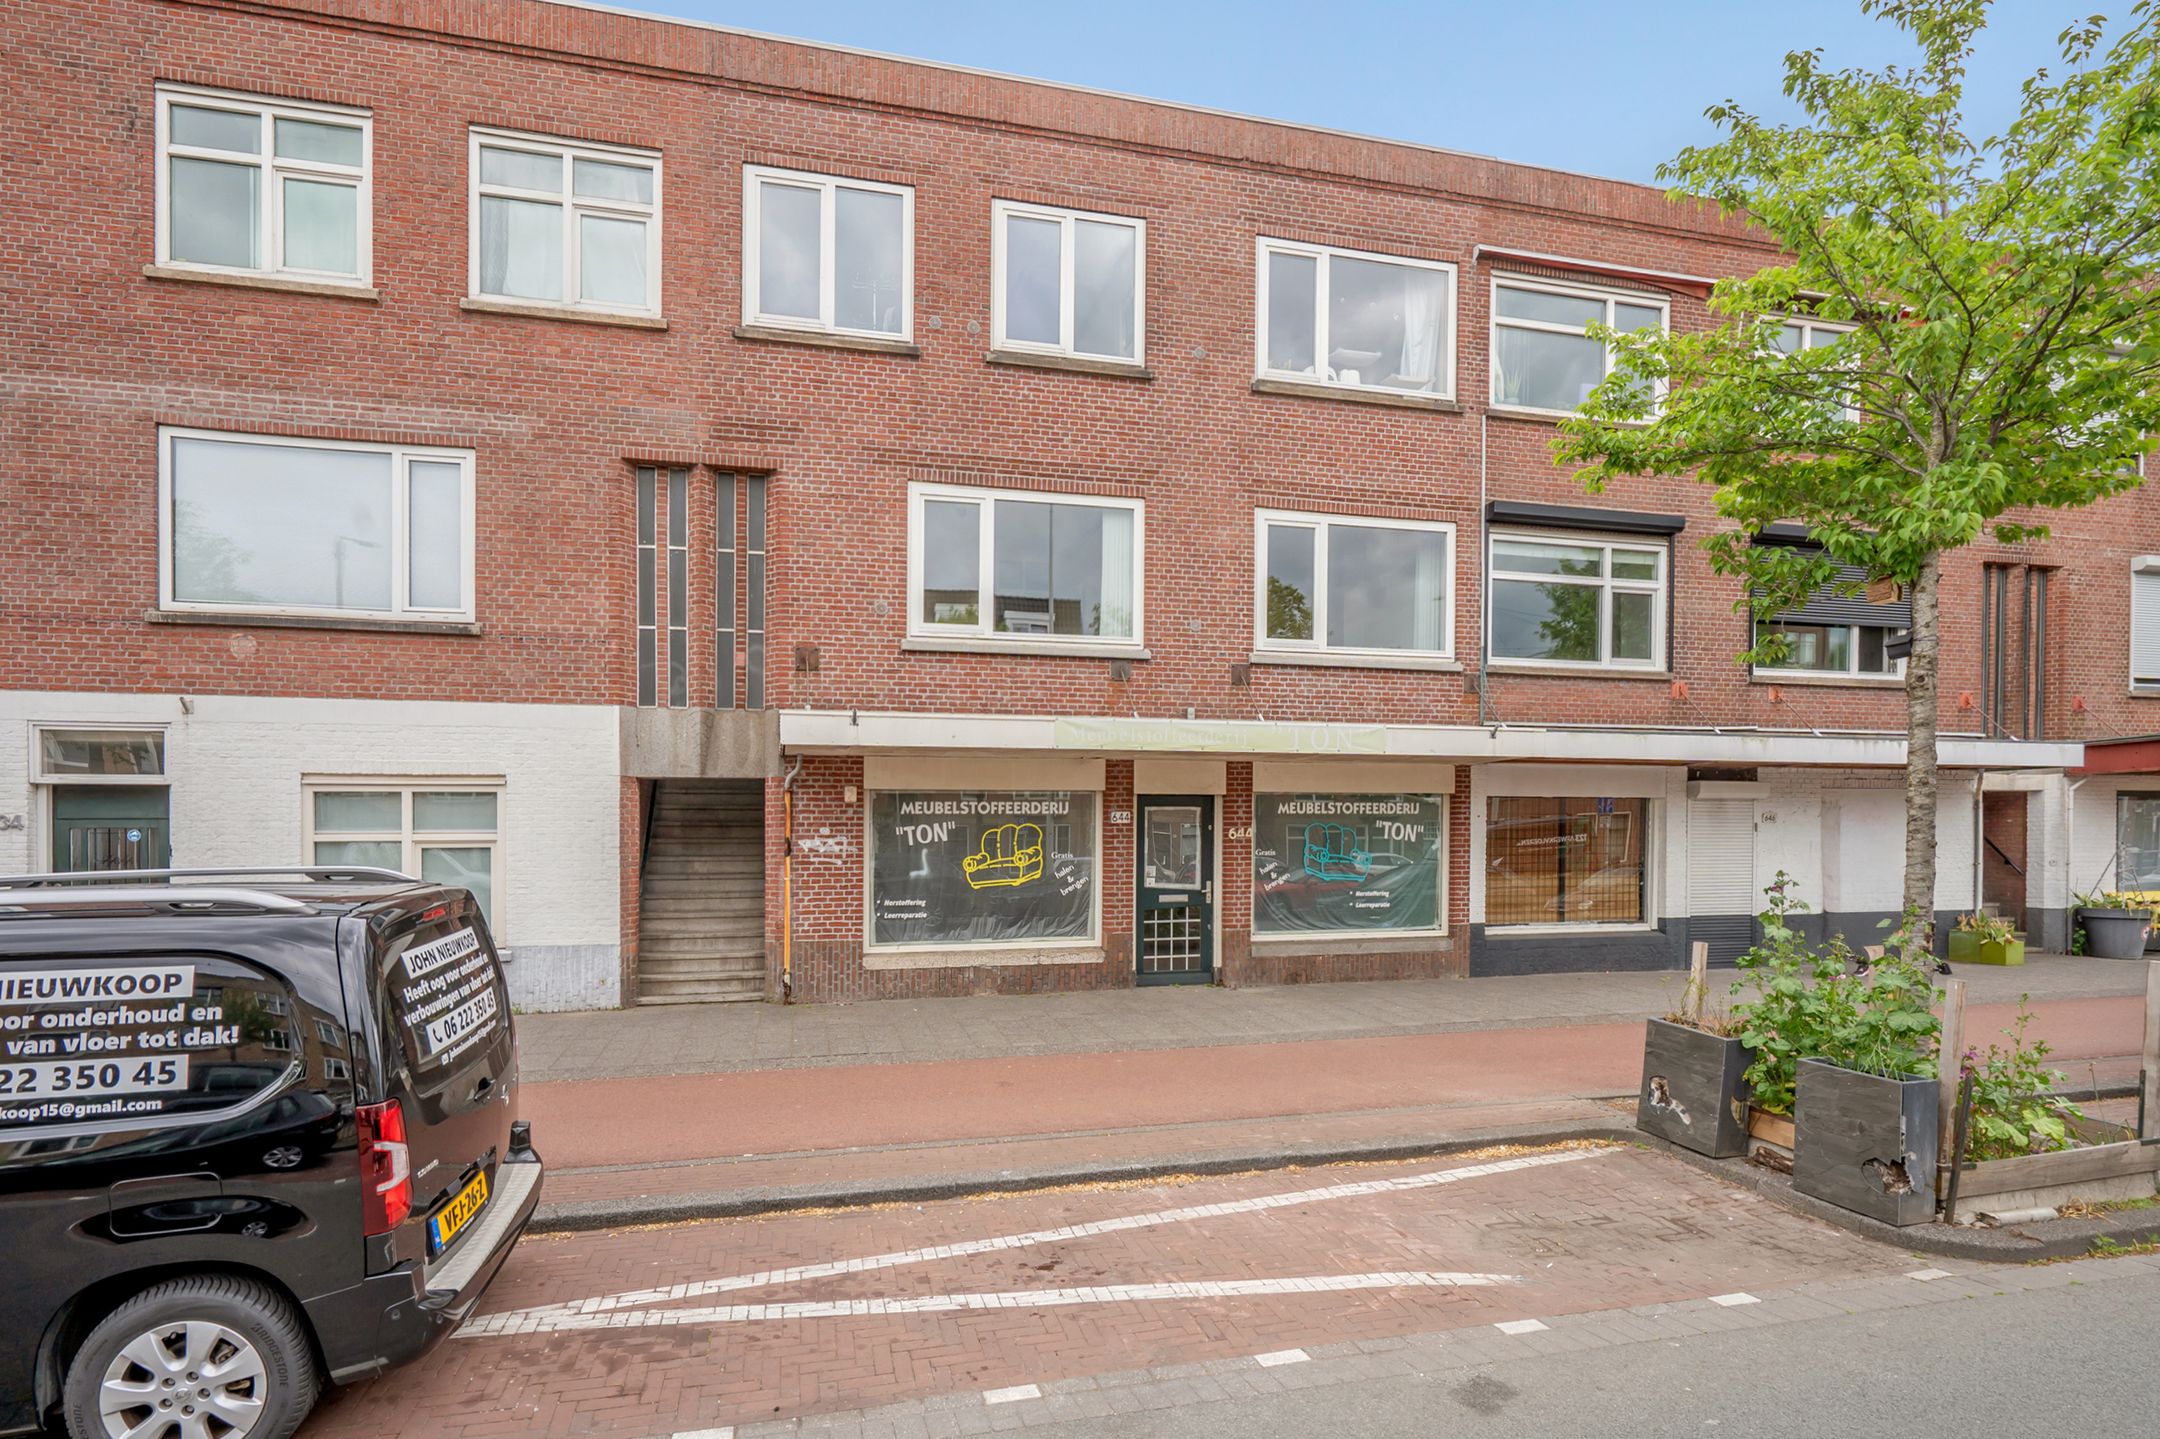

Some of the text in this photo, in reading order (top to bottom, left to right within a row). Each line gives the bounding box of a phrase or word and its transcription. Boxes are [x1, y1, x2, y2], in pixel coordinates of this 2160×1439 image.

[901, 801, 1069, 815] MEUBELSTOFFEERDERIJ
[1111, 812, 1130, 823] 644
[1278, 802, 1420, 815] MEUBELSTOFFEERDERIJ
[896, 821, 956, 846] "TON"
[1376, 820, 1424, 842] "TON"
[1051, 851, 1073, 859] Gratis
[1055, 865, 1074, 879] halen
[1067, 875, 1074, 883] &
[1259, 862, 1278, 875] halen
[1060, 876, 1089, 896] brengen
[1264, 873, 1290, 891] brengen
[884, 912, 928, 920] Leerreparatie
[409, 932, 476, 973] JOHN NIEUWKOOP
[0, 973, 183, 999] IEUWKOOP
[403, 979, 431, 1003] Heeft
[430, 975, 447, 990] oog
[444, 968, 460, 983] voor
[404, 990, 461, 1027] verbouwingen
[458, 983, 471, 997] van
[0, 1003, 223, 1031] or onderhoud en
[444, 1016, 457, 1039] 06
[458, 1006, 474, 1031] 222
[474, 997, 487, 1019] 350
[7, 1025, 240, 1055] van vloer tot dak!
[52, 1063, 121, 1092] 350
[132, 1060, 177, 1086] 45
[444, 1178, 485, 1233] VFJ-26-Z
